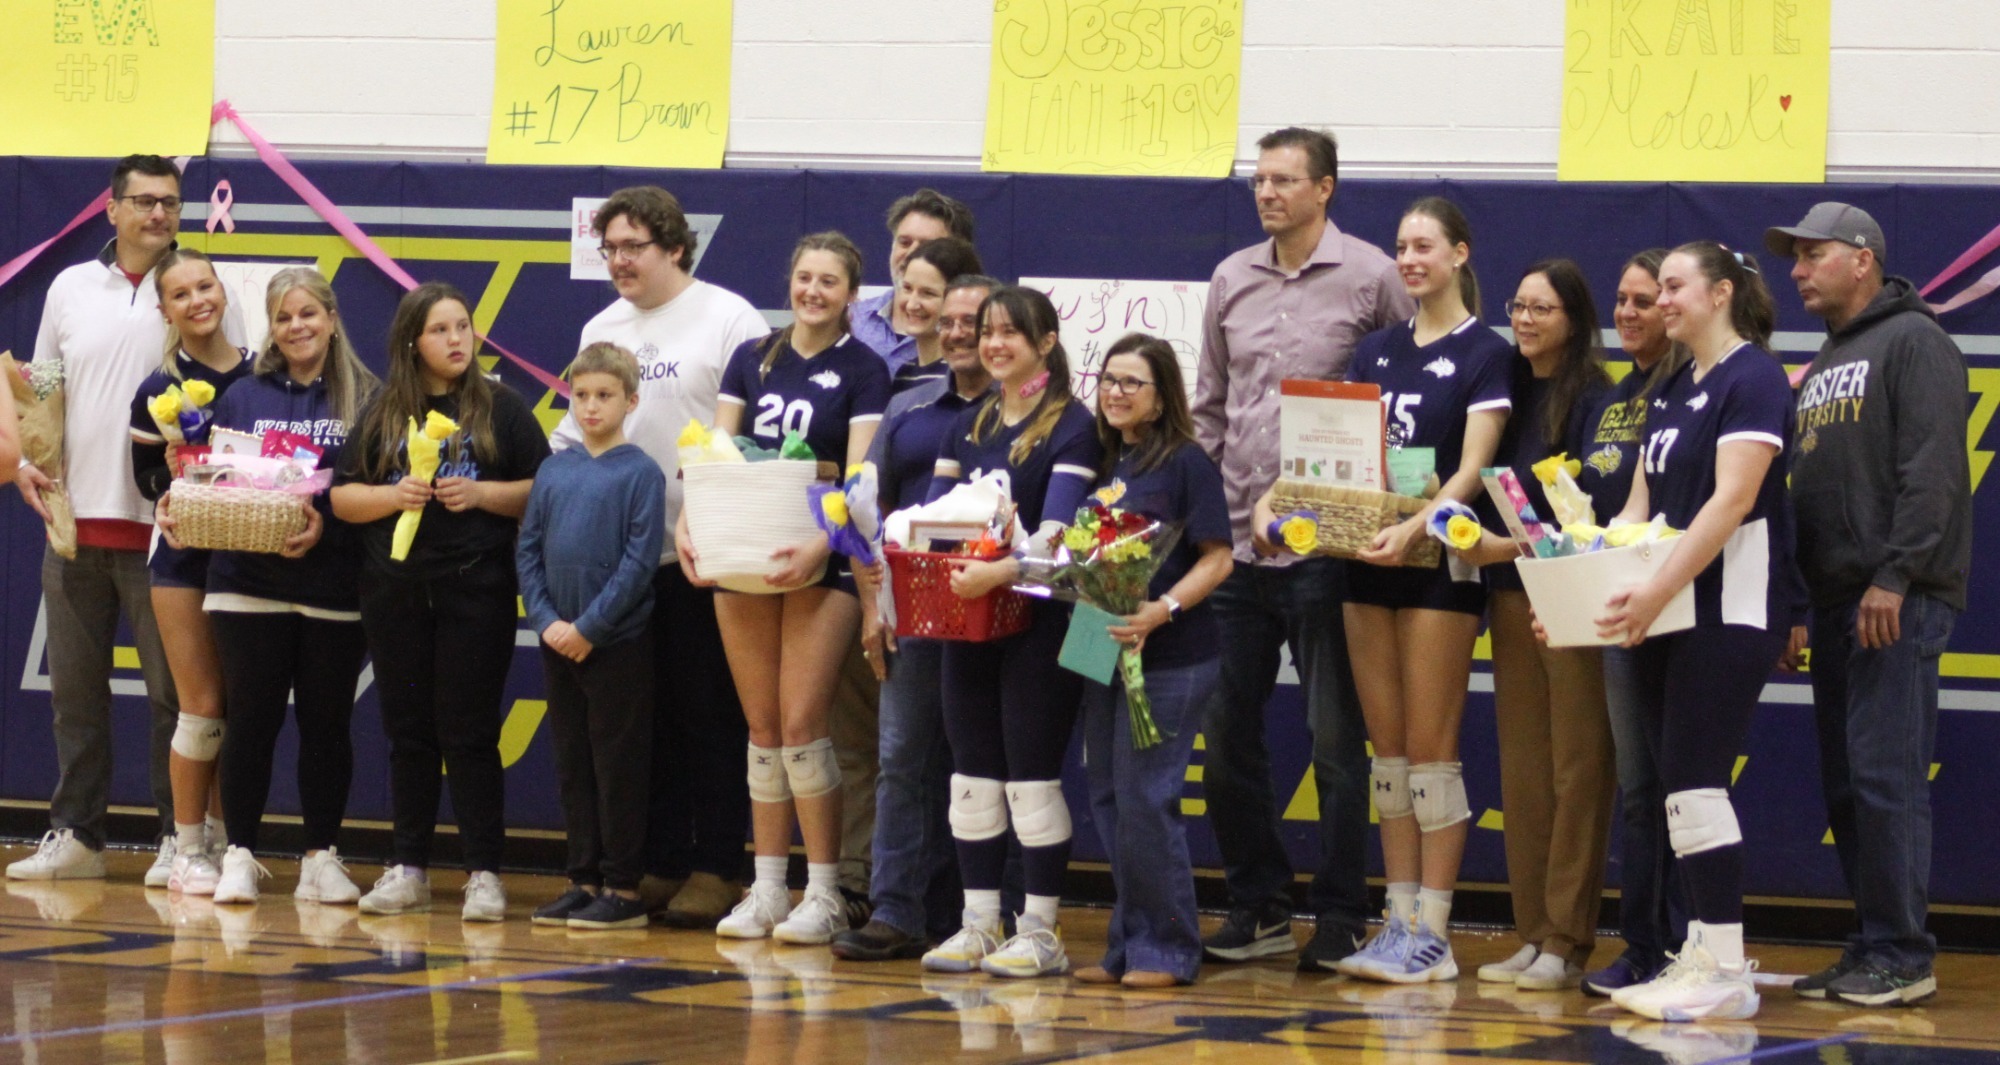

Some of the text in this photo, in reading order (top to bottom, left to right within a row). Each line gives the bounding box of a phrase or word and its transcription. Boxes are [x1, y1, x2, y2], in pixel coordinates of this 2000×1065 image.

[54, 0, 160, 46] EVA
[534, 0, 694, 67] Lauren
[1000, 0, 1223, 79] Jessie
[54, 53, 139, 103] #15
[504, 62, 719, 145] #17 Brown
[1119, 83, 1210, 157] #19
[753, 393, 814, 441] 20
[1298, 433, 1365, 447] HAUNTED GHOSTS
[1644, 428, 1680, 474] 17
